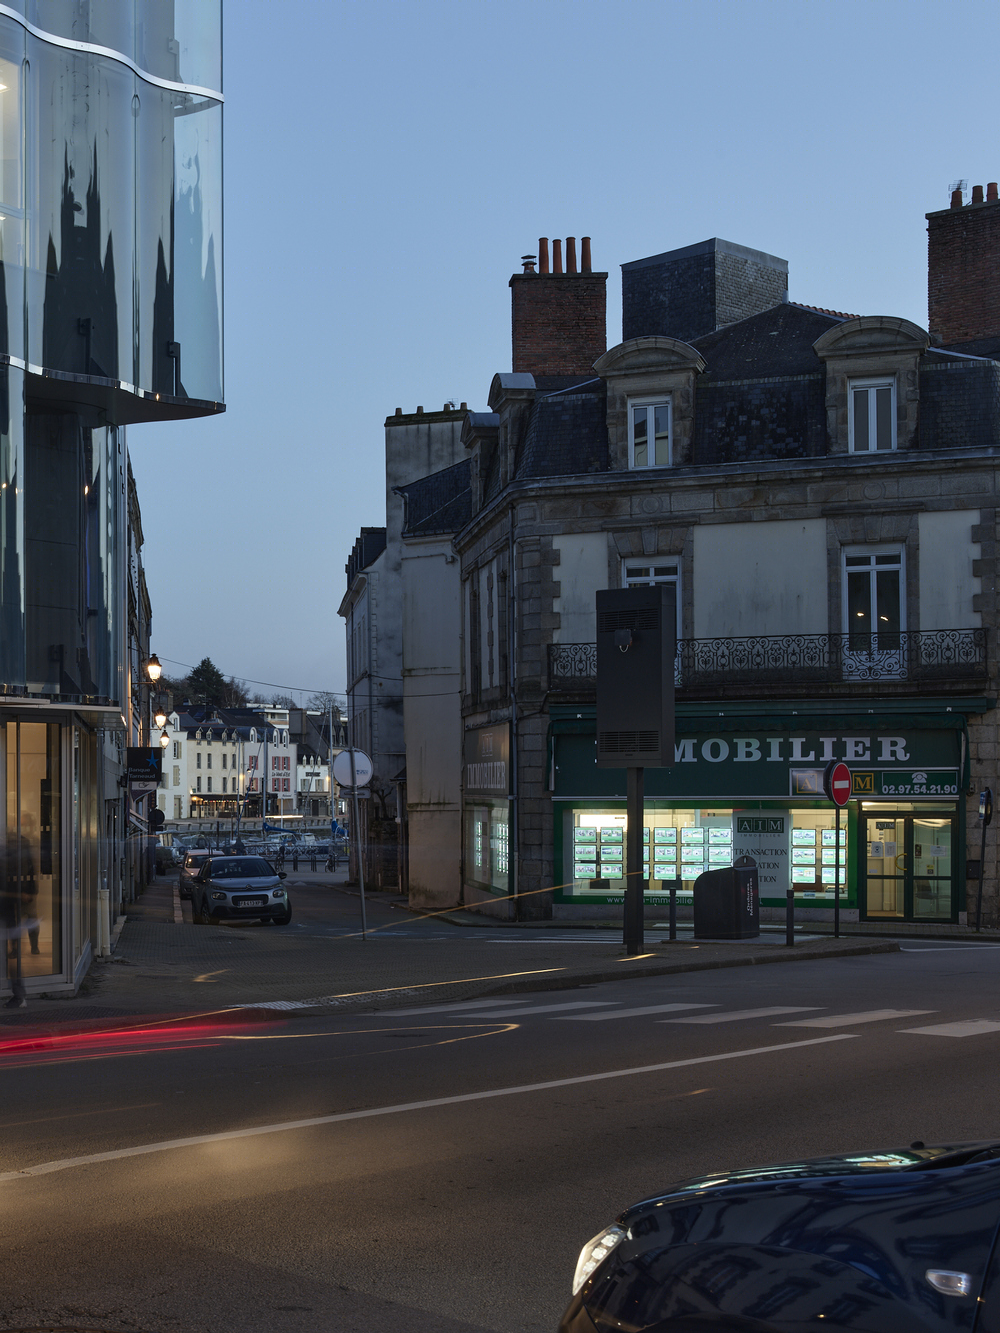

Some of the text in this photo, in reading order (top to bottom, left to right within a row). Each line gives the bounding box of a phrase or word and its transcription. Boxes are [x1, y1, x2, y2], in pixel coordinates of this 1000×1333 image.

[674, 736, 911, 763] MOBILIER
[467, 761, 506, 790] IMMOBILIER
[882, 783, 958, 794] 02.97.54.21.90
[740, 819, 782, 831] AIM
[734, 848, 788, 856] TRANSACTION
